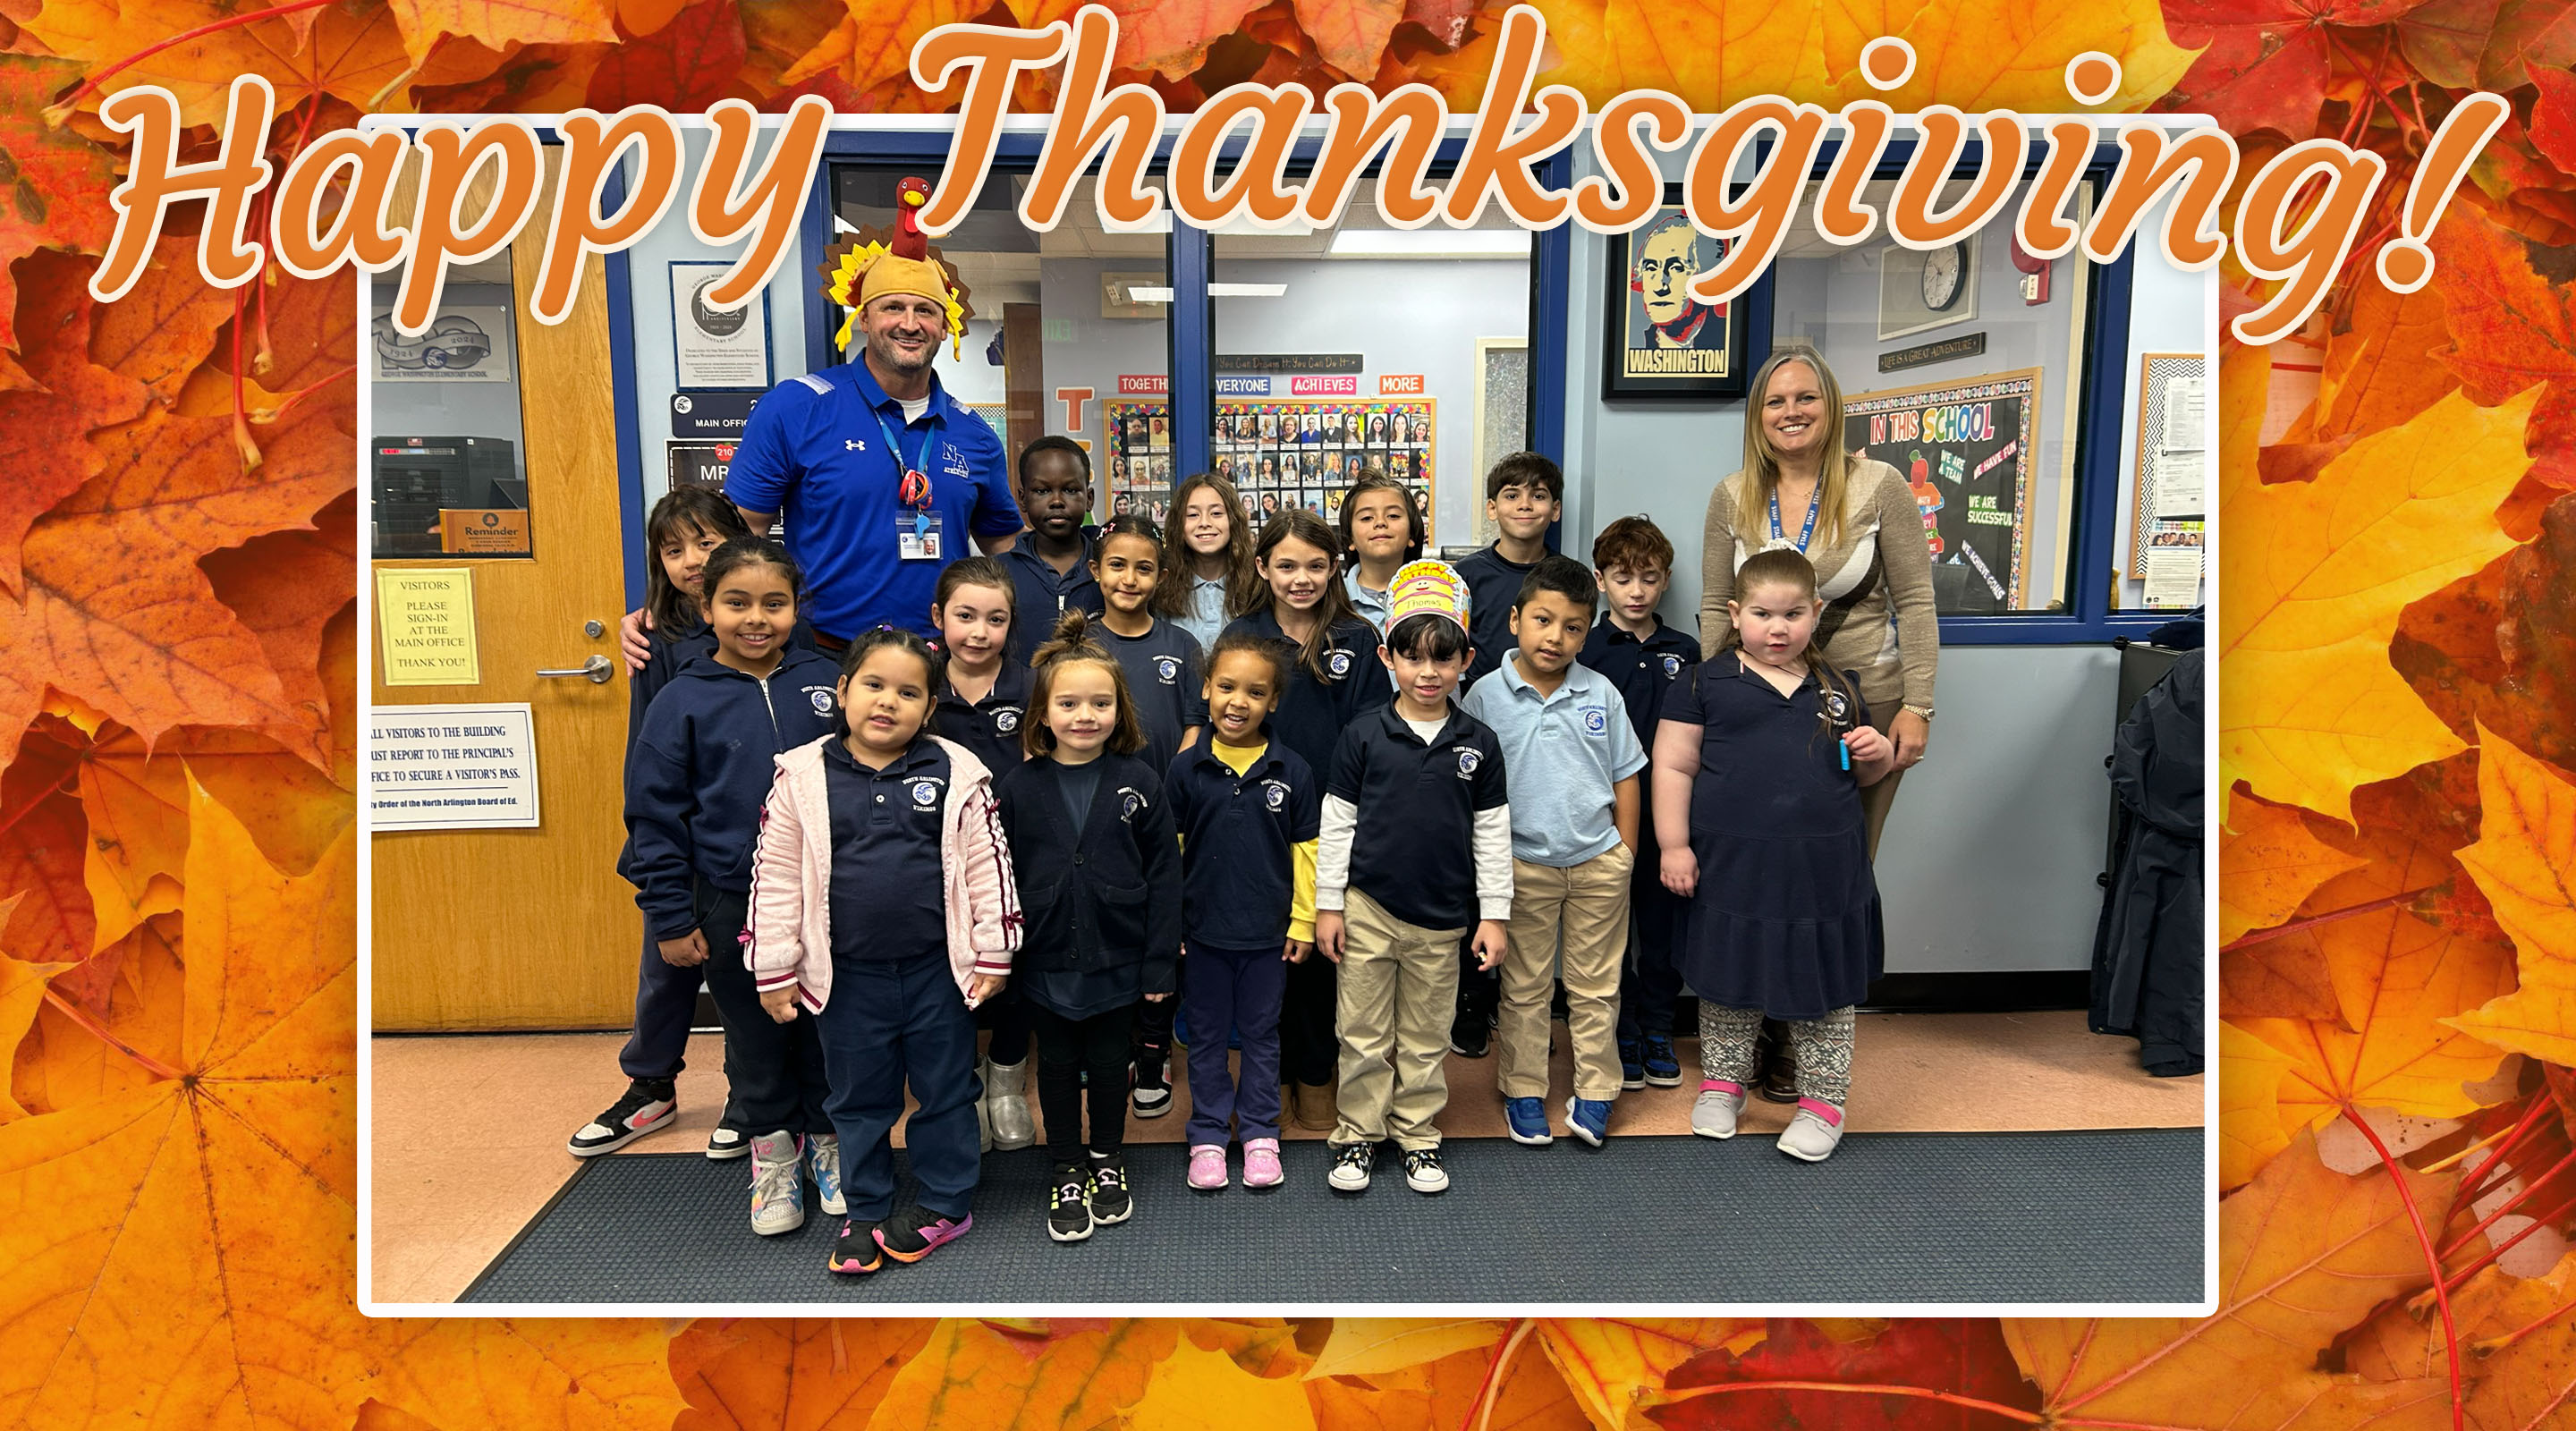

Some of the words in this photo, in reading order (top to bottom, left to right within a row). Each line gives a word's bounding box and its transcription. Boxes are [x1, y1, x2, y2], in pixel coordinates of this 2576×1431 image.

[1629, 349, 1724, 372] WASHINGTON
[1122, 377, 1167, 391] TOGETH
[1216, 379, 1268, 392] VERYONE
[1294, 378, 1353, 391] ACHIEVES
[1382, 377, 1419, 391] MORE
[695, 419, 719, 428] MAIN
[723, 419, 748, 428] OFFI
[1870, 414, 1887, 445] IN
[1889, 410, 1919, 443] THIS
[1922, 402, 1995, 444] SCHOOL
[717, 448, 733, 456] 210
[1983, 451, 2003, 471] HAVE
[2003, 440, 2017, 459] FUN
[1941, 449, 1953, 463] WE
[1952, 455, 1966, 471] ARE
[700, 465, 729, 480] MR
[1945, 467, 1962, 485] TEAM
[1969, 495, 1980, 508] WE
[1982, 495, 1996, 509] ARE
[1968, 511, 2012, 527] SUCCESSFUL
[465, 527, 519, 536] Reminder
[1399, 562, 1448, 578] HAPPY
[401, 581, 451, 590] VISITORS
[1392, 569, 1458, 592] BIRTHDAY
[407, 602, 447, 611] PLEASE
[407, 614, 448, 622] SIGN-IN
[410, 626, 423, 635] AT
[427, 626, 449, 634] THE
[394, 639, 423, 648] MAIN
[427, 638, 465, 647] OFFICE
[397, 658, 436, 667] THANK
[438, 657, 465, 666] YOU!
[386, 727, 425, 739] VISITORS
[428, 727, 440, 738] TO
[442, 726, 461, 738] THE
[463, 725, 506, 737] BUILDING
[371, 749, 387, 760] UST
[391, 749, 424, 760] REPORT
[428, 749, 439, 759] TO
[442, 749, 460, 759] THE
[462, 747, 514, 758] PRINCIPAL'S
[371, 771, 390, 782] FICE
[394, 771, 406, 782] TO
[409, 769, 443, 781] SECURE
[445, 770, 453, 780] A
[455, 768, 497, 780] VISITOR'S
[499, 767, 521, 779] PASS.
[421, 799, 442, 807] North
[443, 799, 477, 807] Arlington
[477, 798, 498, 806] Board
[507, 797, 518, 805] Ed.
